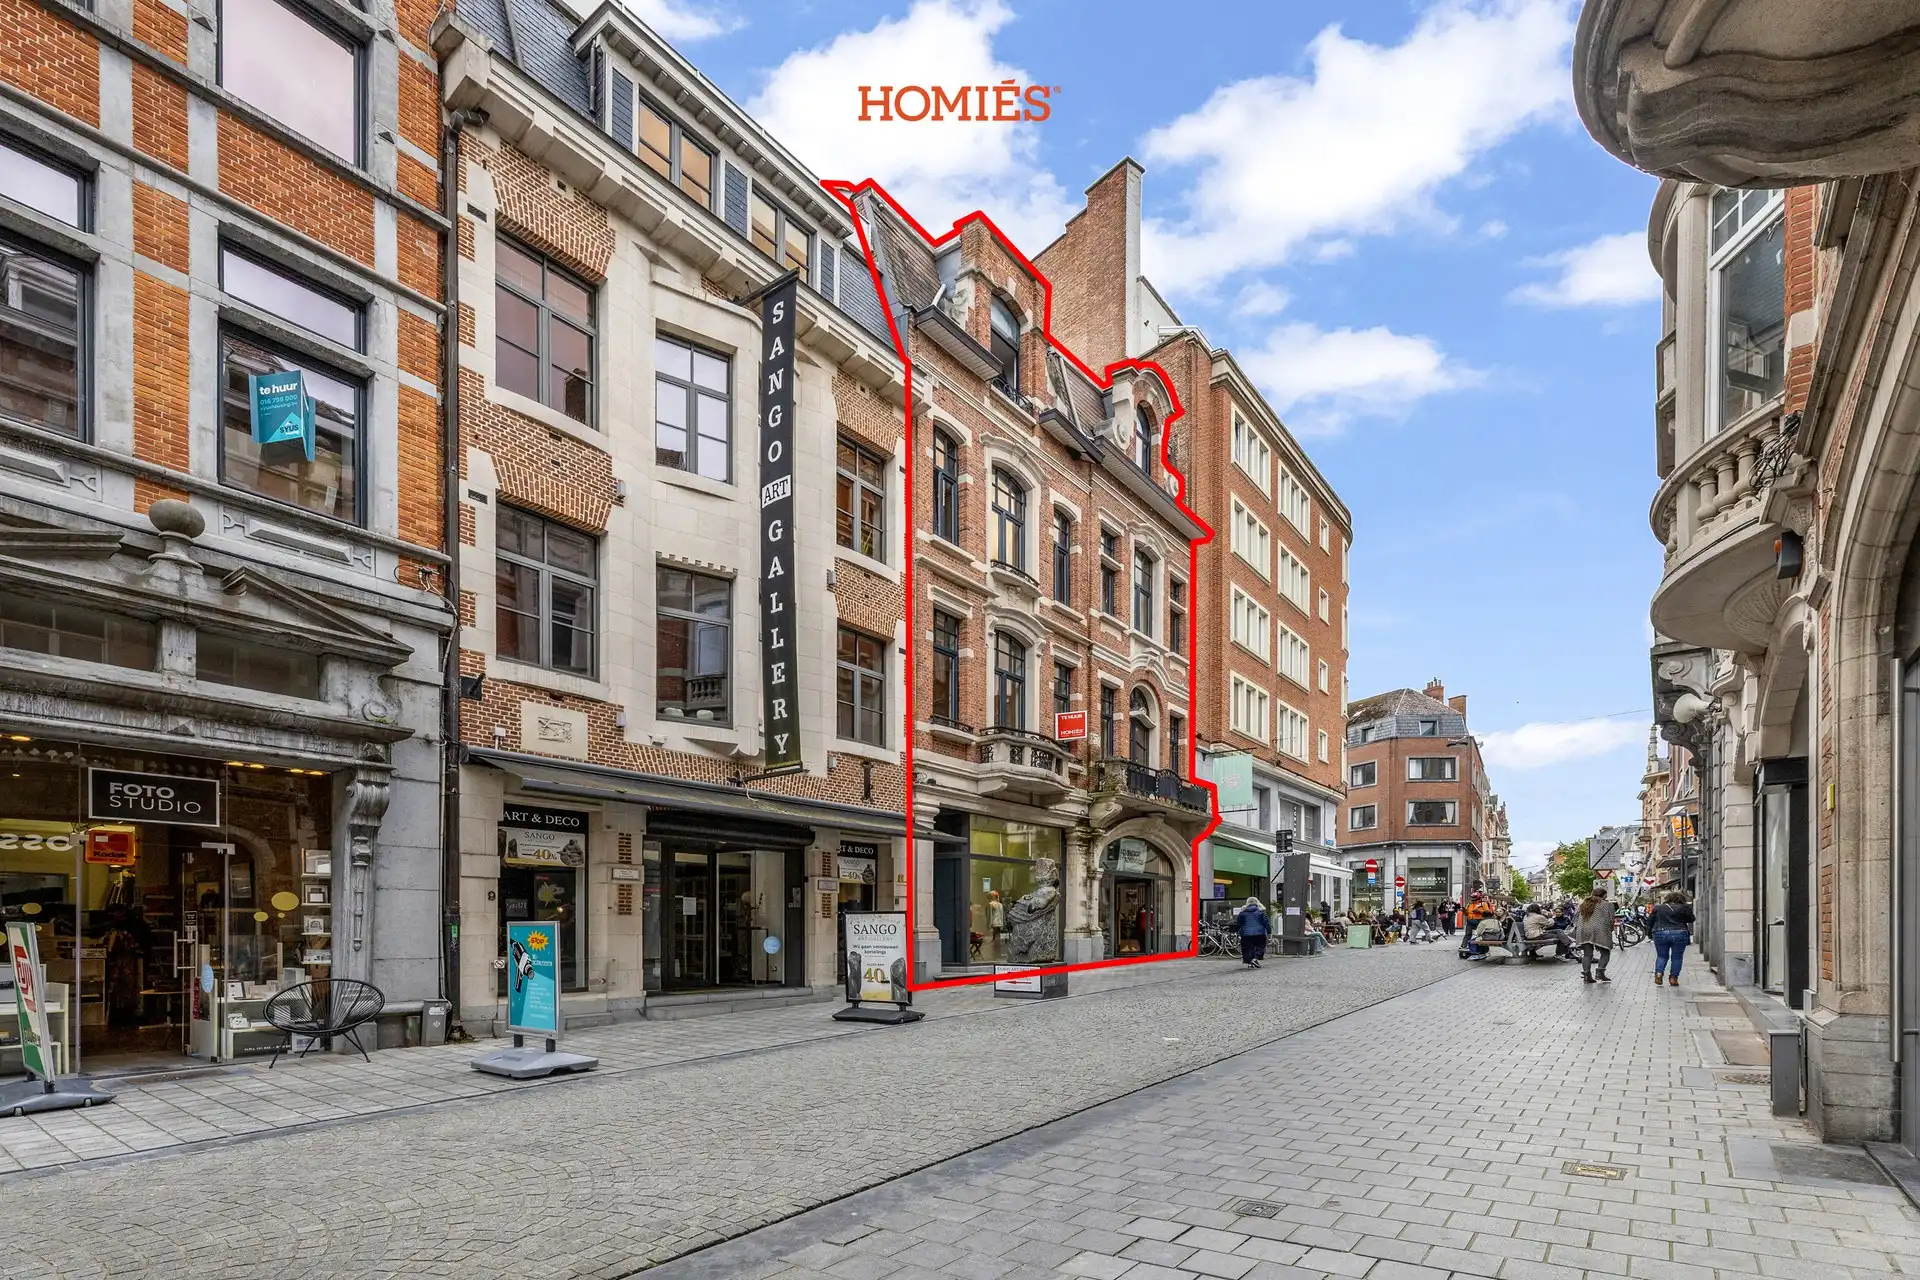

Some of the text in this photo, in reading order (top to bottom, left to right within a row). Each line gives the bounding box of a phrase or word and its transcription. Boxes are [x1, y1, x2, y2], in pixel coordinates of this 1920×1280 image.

[259, 382, 298, 395] te huur
[767, 301, 785, 464] SANGO
[763, 479, 789, 505] ART
[768, 519, 789, 755] GALLERY
[109, 782, 175, 799] FOTO
[109, 795, 201, 814] STUDIO
[503, 811, 580, 827] ART & DECO
[524, 831, 555, 840] SANGO
[847, 845, 854, 853] &
[855, 846, 874, 855] DECO
[853, 924, 897, 935] SANGO
